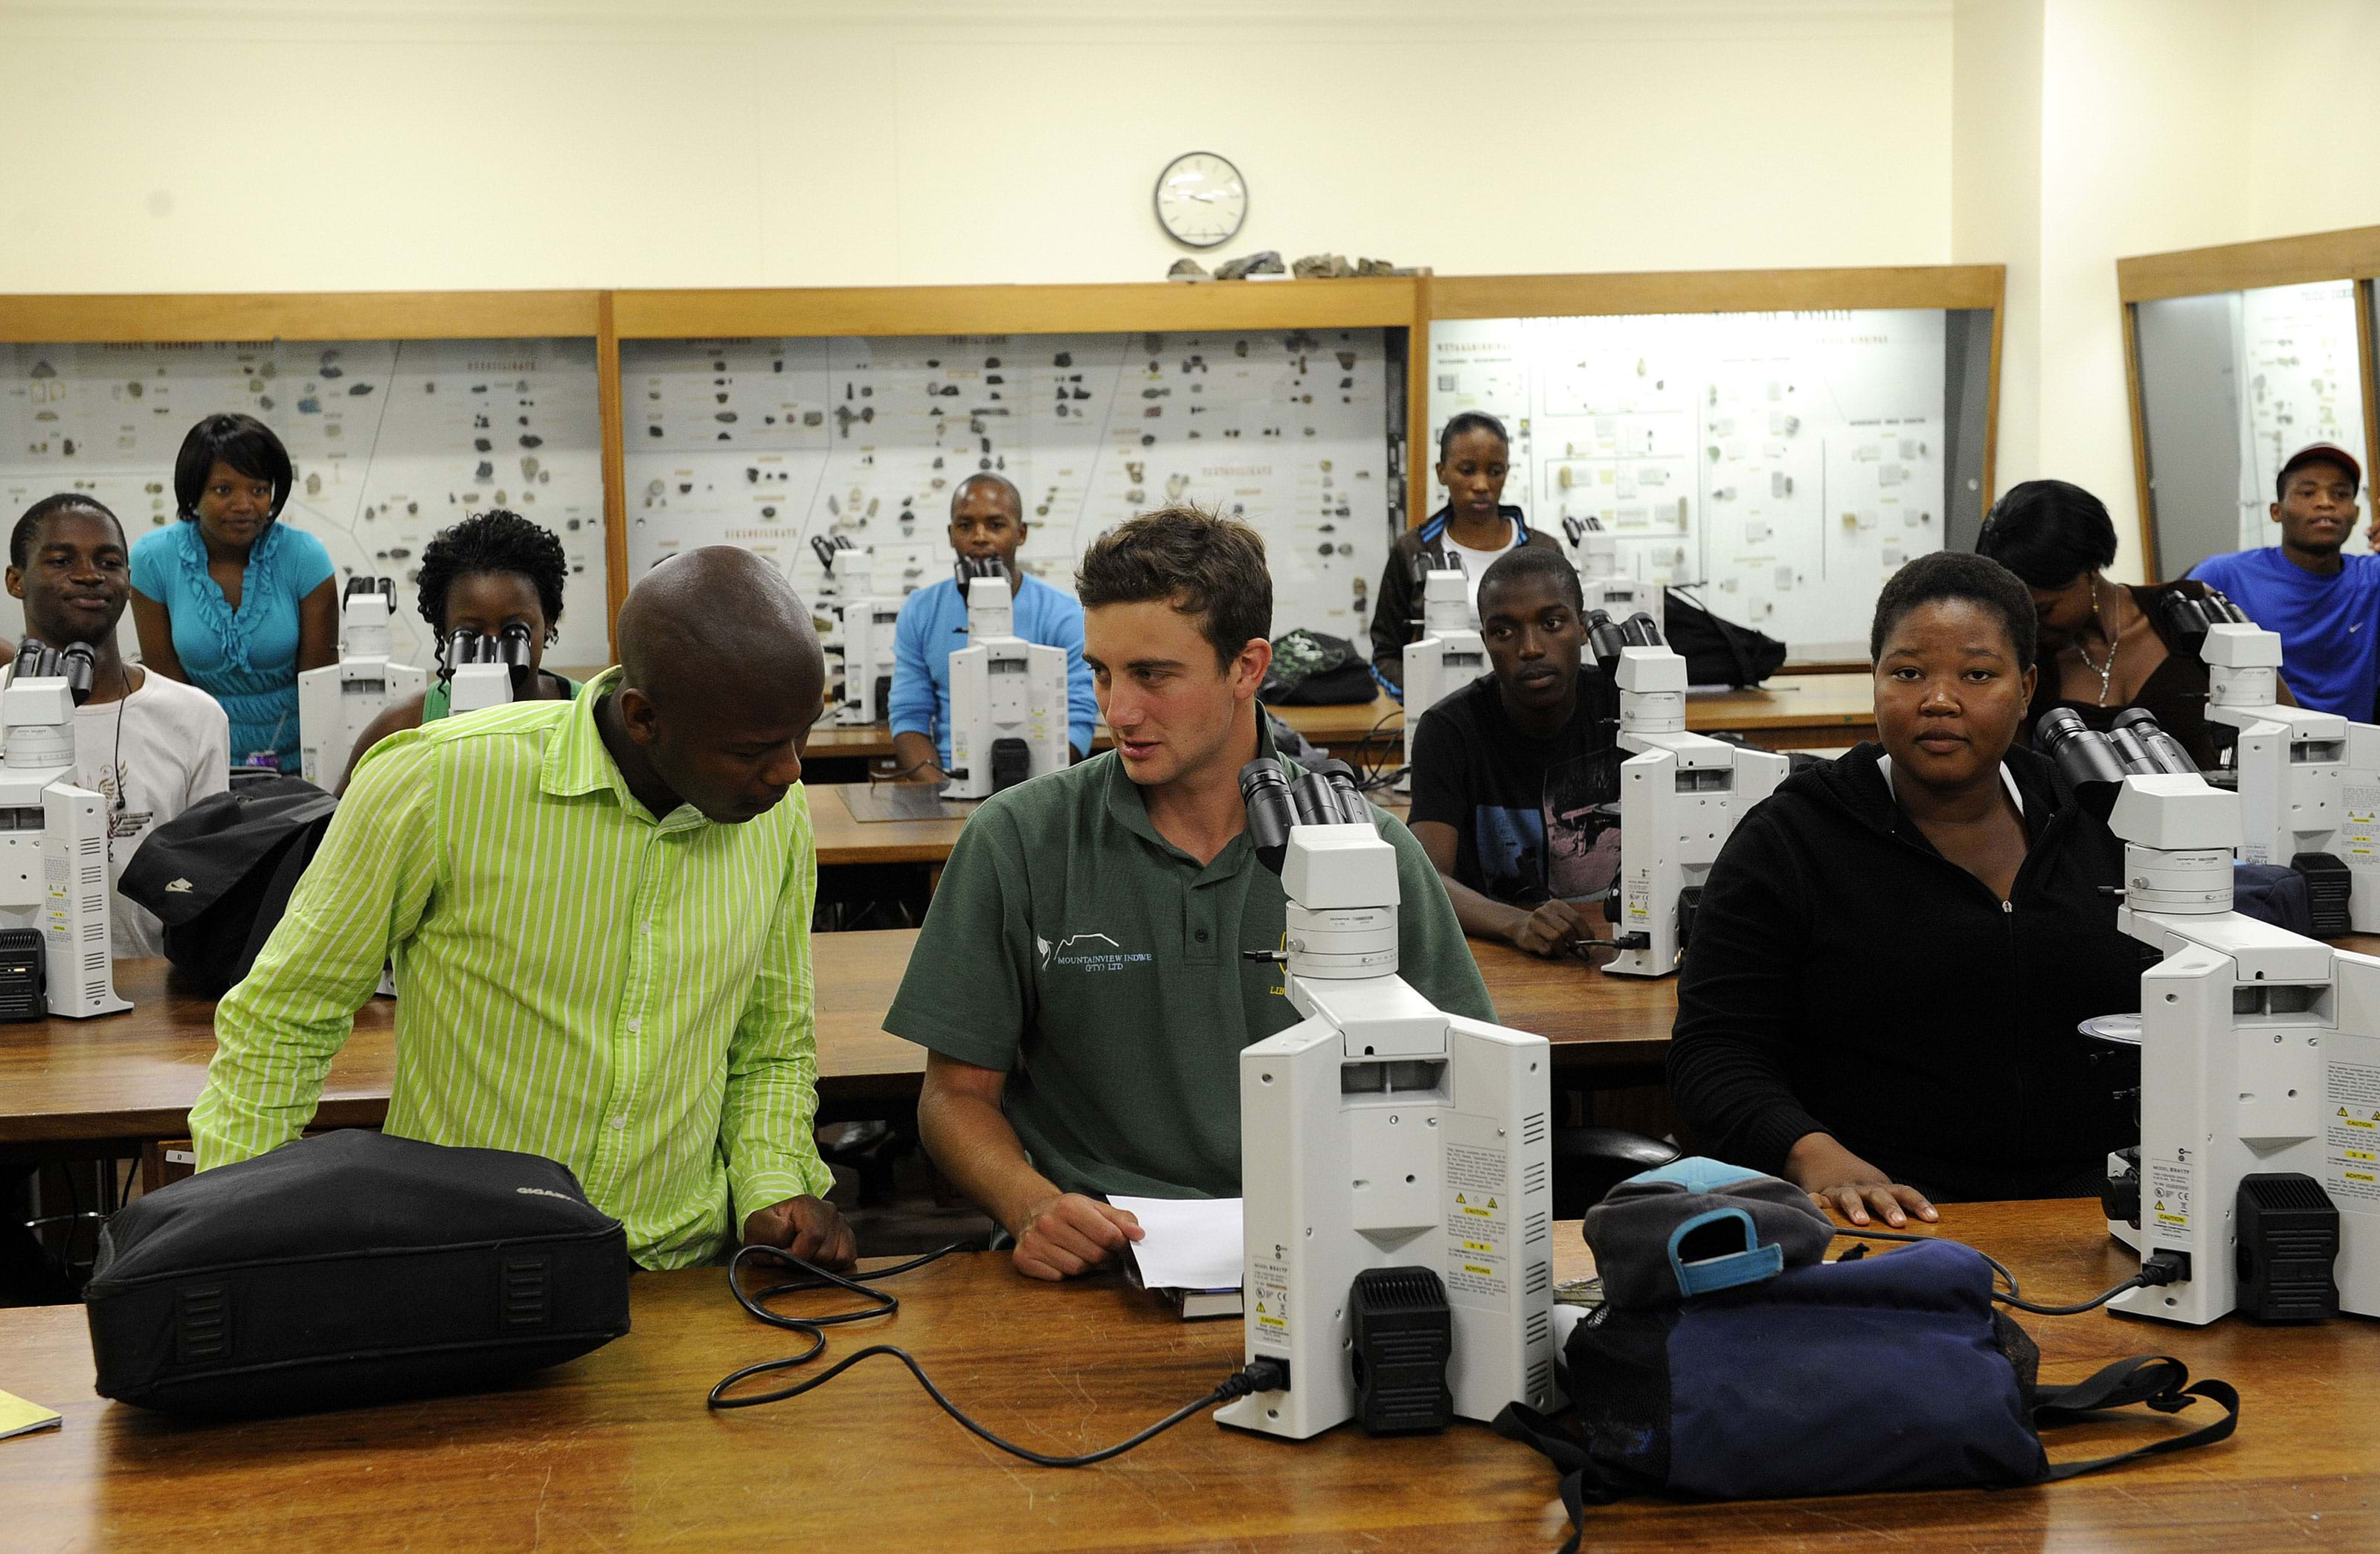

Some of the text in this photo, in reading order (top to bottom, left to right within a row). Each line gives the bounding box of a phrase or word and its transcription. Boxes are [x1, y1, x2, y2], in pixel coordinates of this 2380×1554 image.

[1058, 953, 1152, 964] MOUNTAINVIEW INDWE
[1085, 964, 1105, 972] (PTY)
[2347, 1120, 2373, 1128] CAUTION
[2346, 1173, 2373, 1181] ACHTUNG
[1464, 1208, 1489, 1217] CAUTION
[1465, 1265, 1490, 1274] ACHTUNG
[1261, 1317, 1284, 1325] CAUTION
